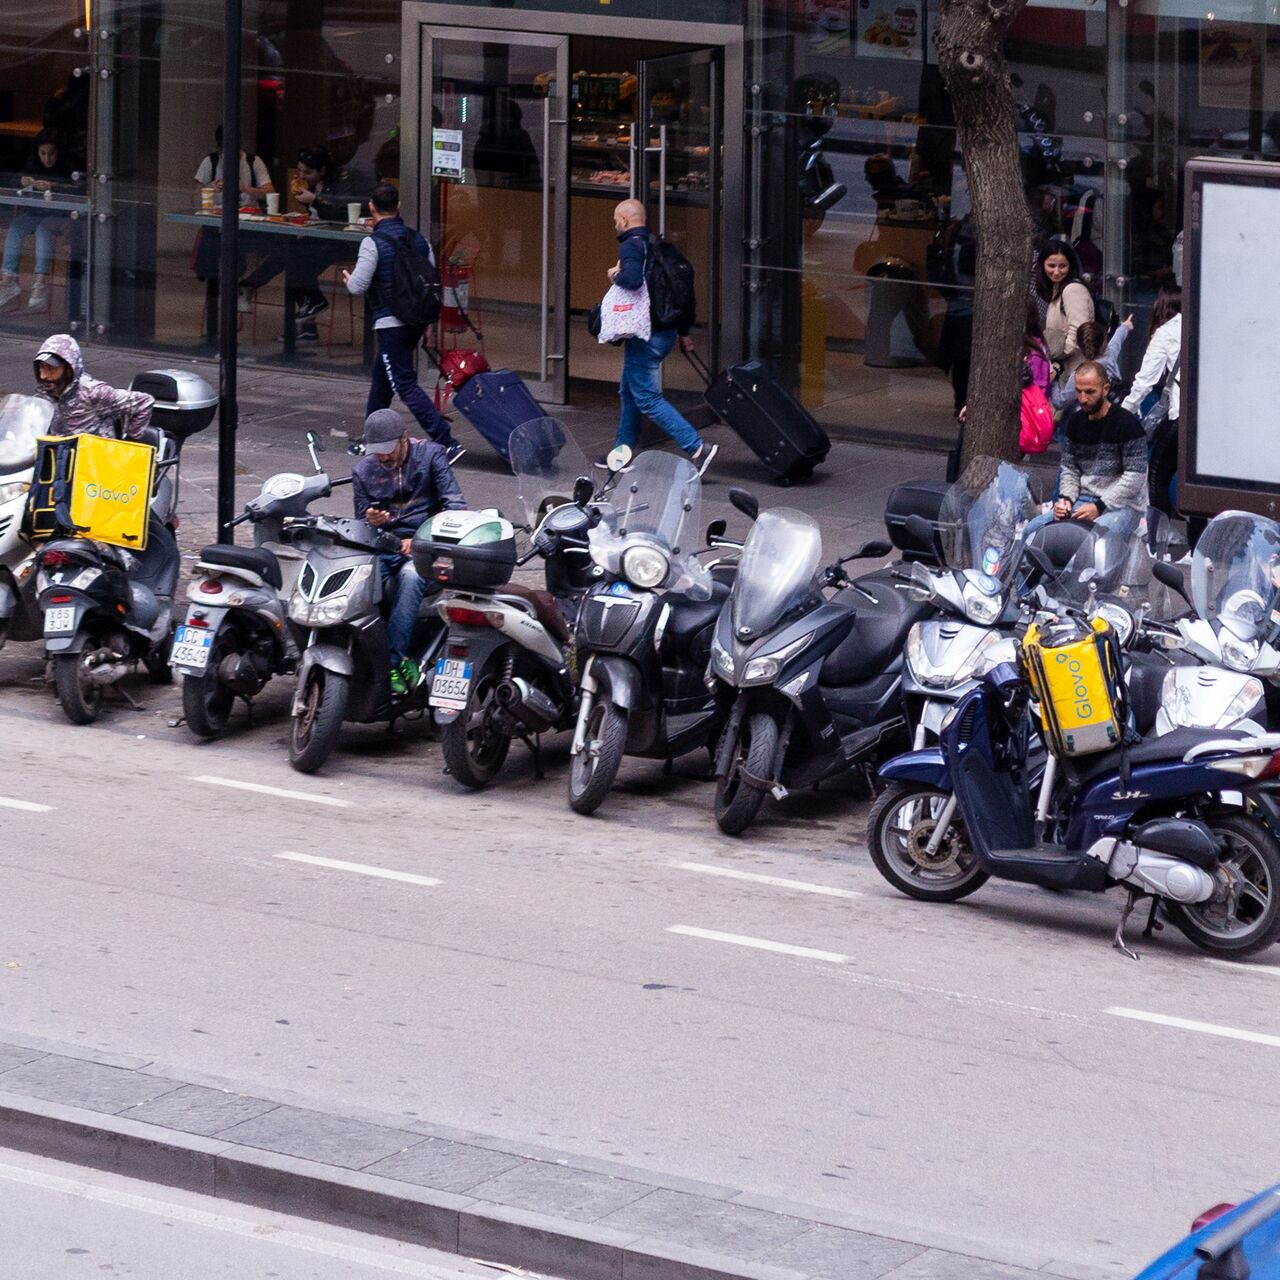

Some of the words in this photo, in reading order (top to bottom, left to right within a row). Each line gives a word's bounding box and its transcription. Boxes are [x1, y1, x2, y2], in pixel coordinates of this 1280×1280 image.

[86, 484, 129, 503] Glovo
[433, 678, 467, 697] 03654
[1068, 660, 1092, 718] Glovo
